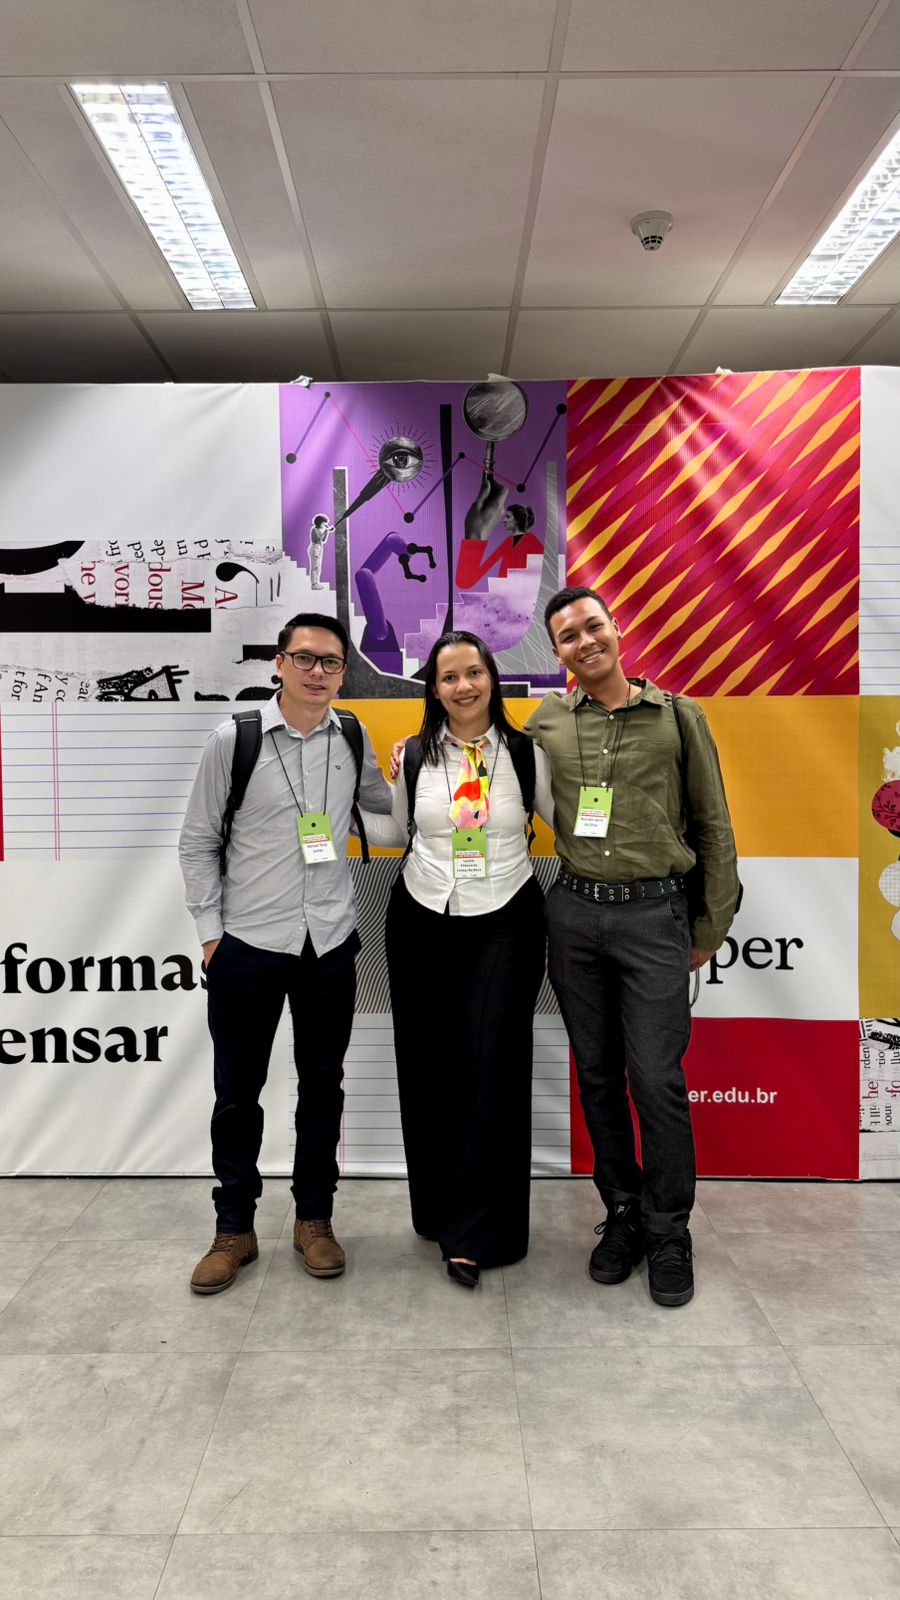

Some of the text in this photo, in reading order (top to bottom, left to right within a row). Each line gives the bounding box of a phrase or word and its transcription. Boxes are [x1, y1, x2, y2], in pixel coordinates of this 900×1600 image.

[0, 942, 208, 994] forma
[0, 1026, 168, 1064] ensar
[688, 1087, 778, 1104] er.edu.br
